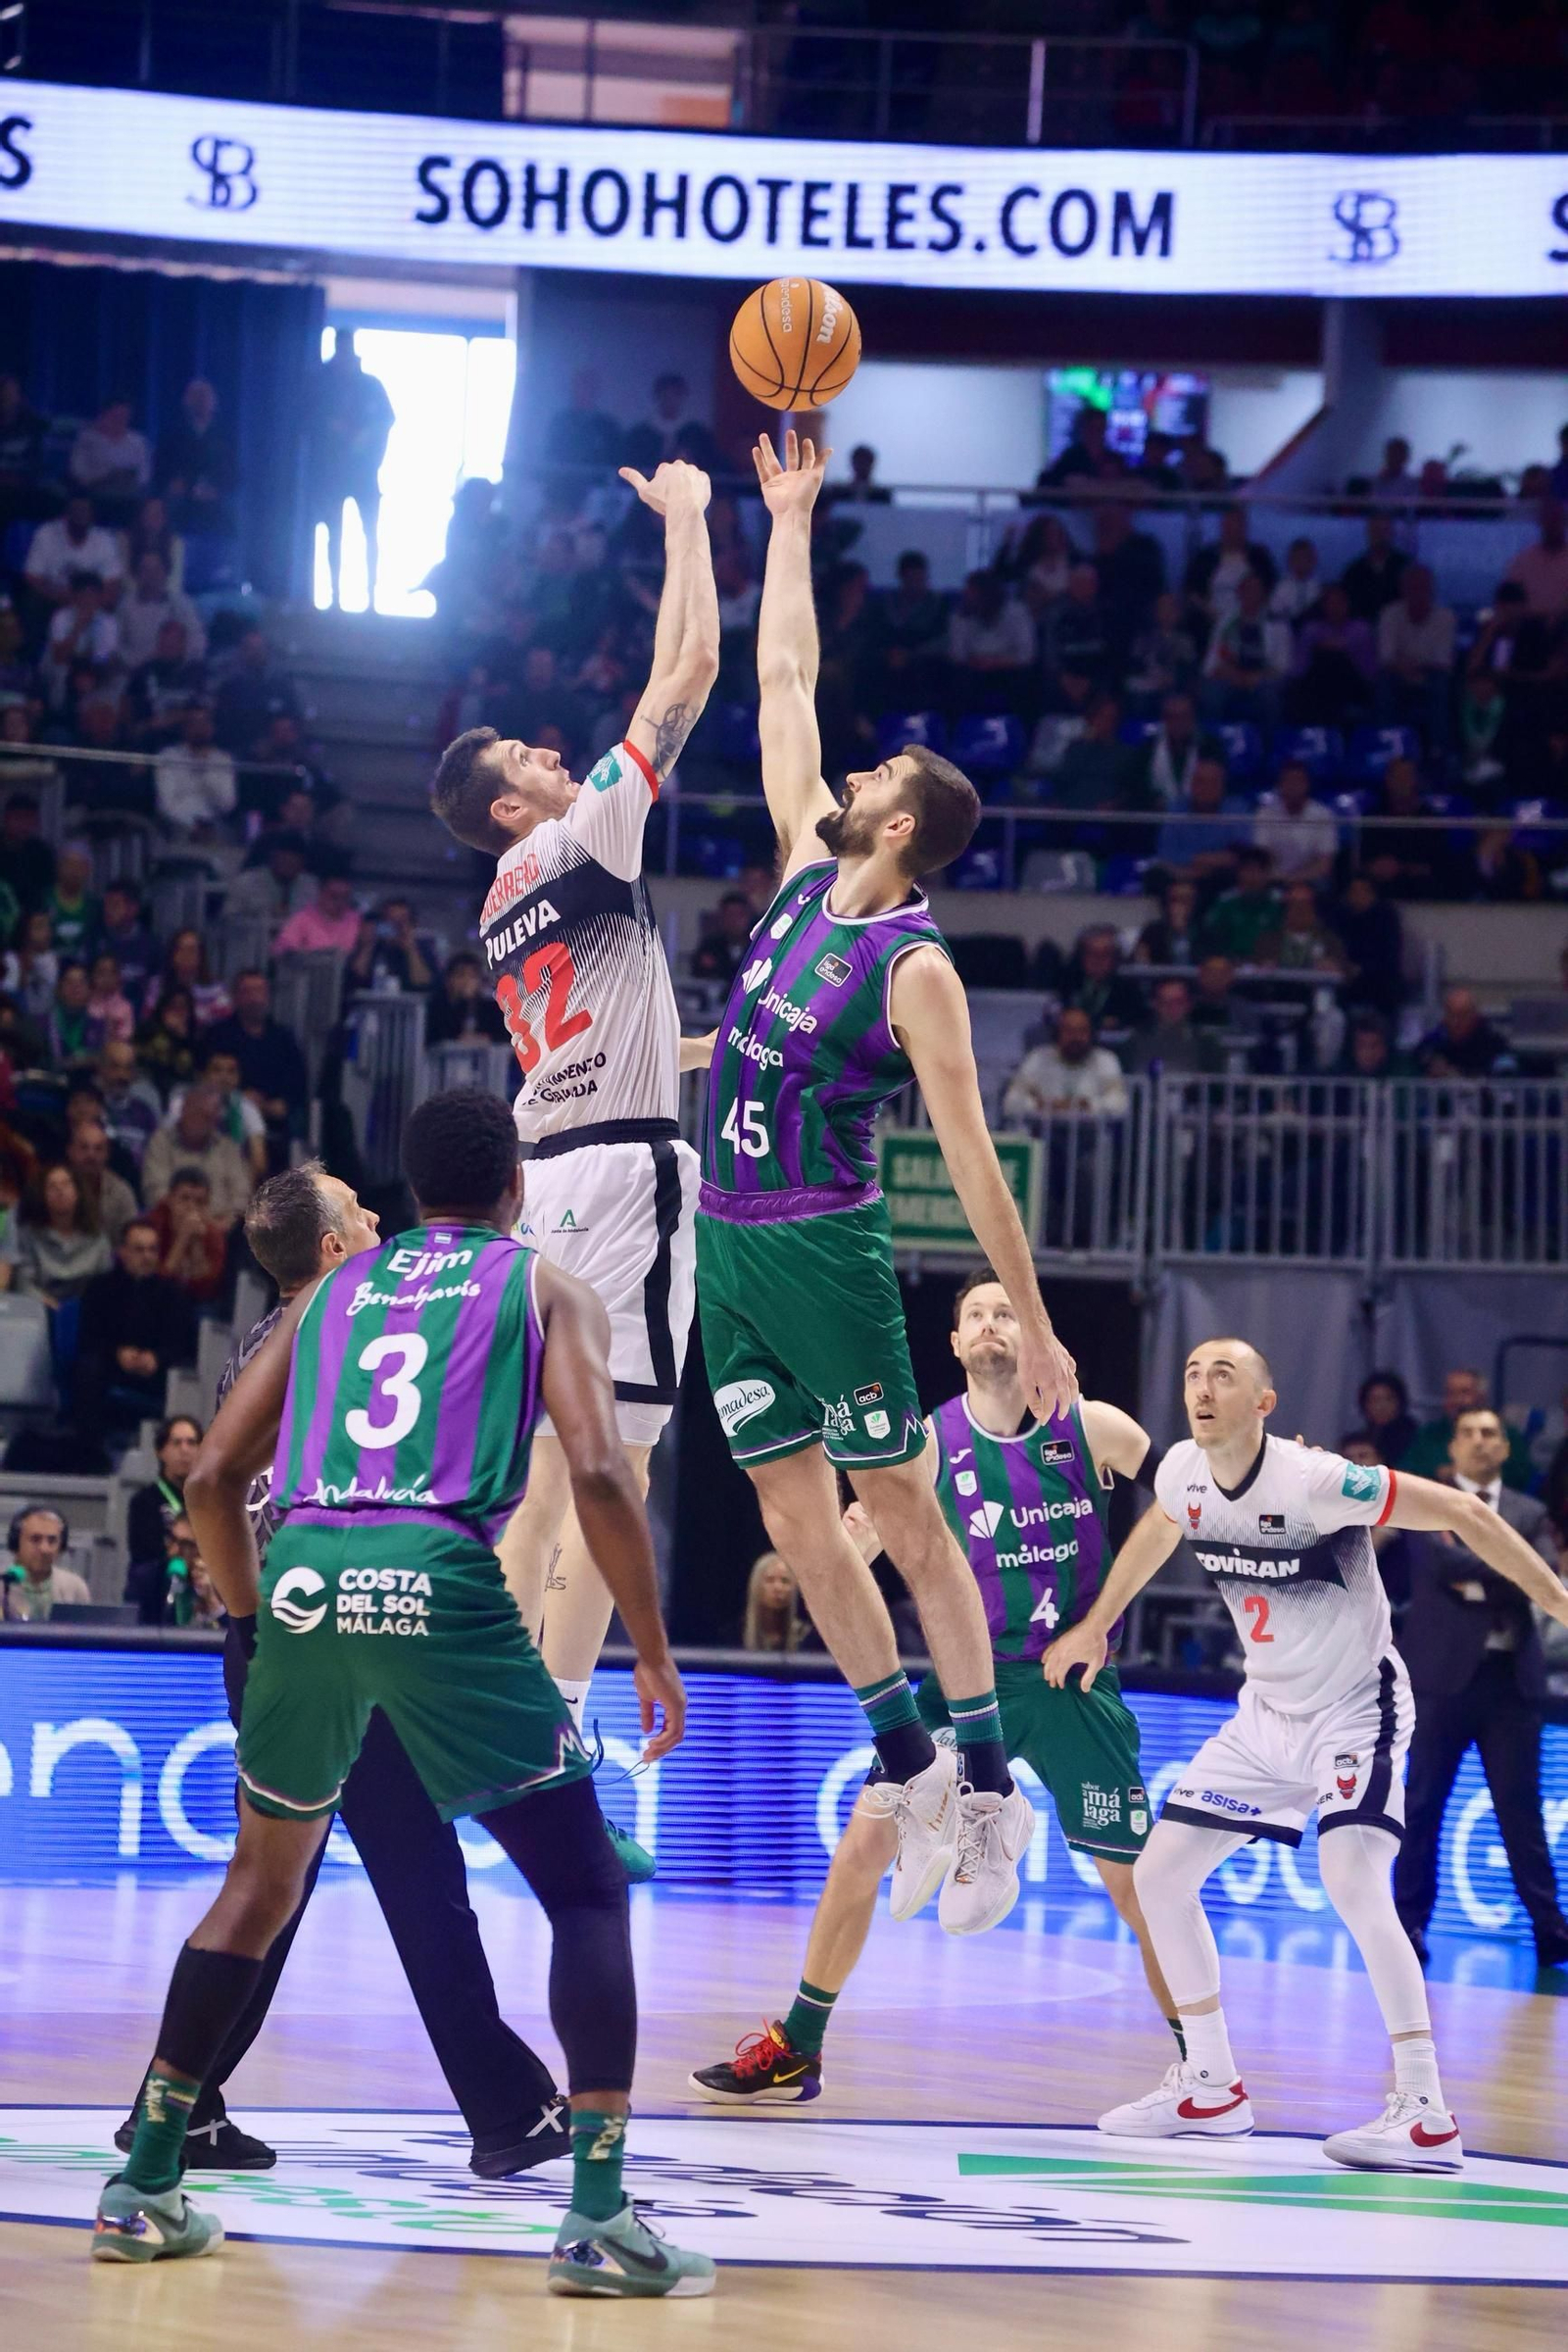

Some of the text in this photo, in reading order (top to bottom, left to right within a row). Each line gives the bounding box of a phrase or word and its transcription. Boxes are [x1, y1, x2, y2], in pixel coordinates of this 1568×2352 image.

[414, 154, 1175, 259] SOHOHOTELES.COM
[816, 281, 844, 344] ilson
[495, 941, 593, 1073] 32
[720, 1097, 770, 1158] 45
[386, 1249, 473, 1282] Ejim
[345, 1332, 428, 1449] 3
[858, 1392, 878, 1403] acb
[1009, 1497, 1094, 1529] Unicaja
[338, 1569, 434, 1596] COSTA
[336, 1594, 431, 1617] DEL SOL
[336, 1613, 429, 1637] MÁLAGA
[1029, 1587, 1060, 1629] 4
[1244, 1595, 1274, 1642] 2
